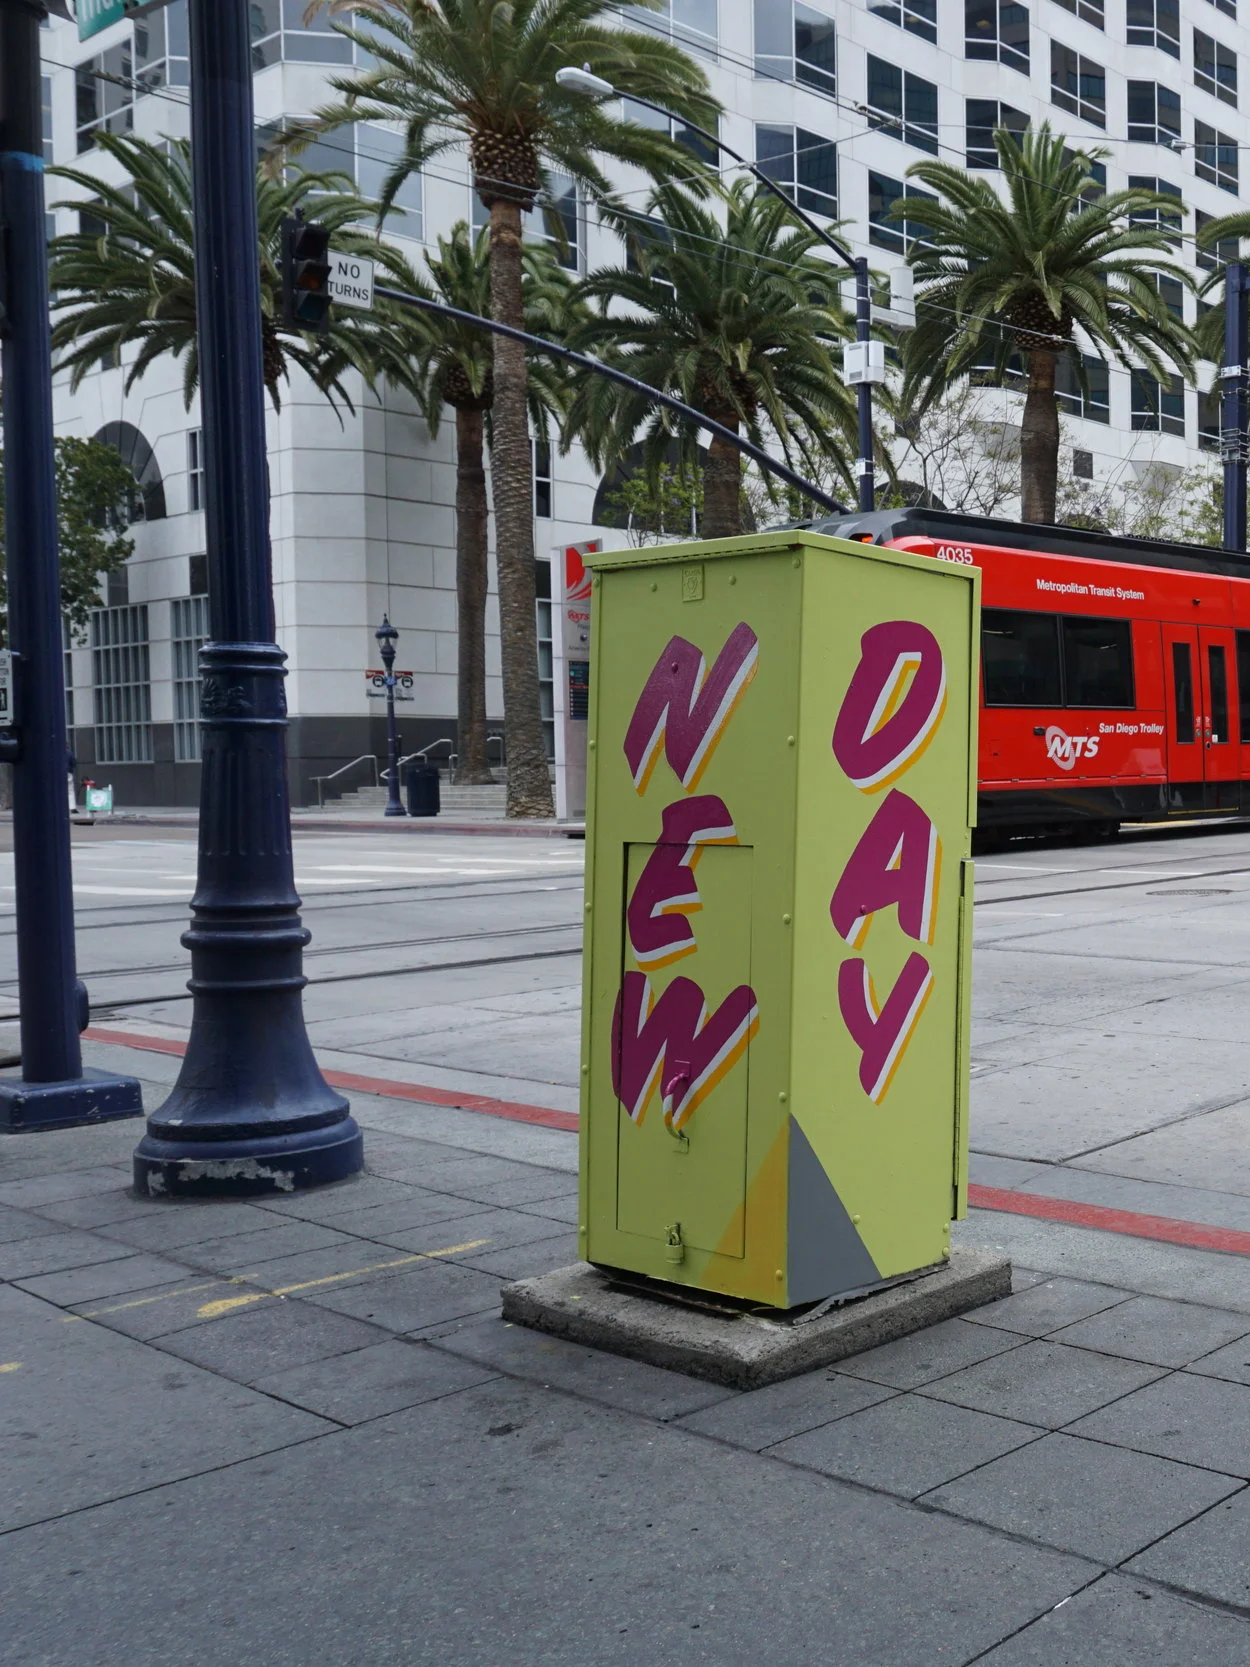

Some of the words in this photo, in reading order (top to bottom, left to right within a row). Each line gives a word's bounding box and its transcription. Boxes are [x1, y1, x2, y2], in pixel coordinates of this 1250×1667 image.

[338, 261, 360, 279] NO
[328, 280, 369, 301] TURNS
[936, 545, 974, 565] 4035
[1036, 578, 1088, 594] Metropolitan
[1089, 584, 1115, 597] Transit
[1116, 587, 1145, 600] System
[1099, 722, 1114, 733] San
[1116, 723, 1138, 735] Diego
[1140, 723, 1164, 735] Trolley
[1047, 736, 1100, 758] MTS
[829, 620, 947, 1106] DAY
[610, 621, 760, 1128] NEW
